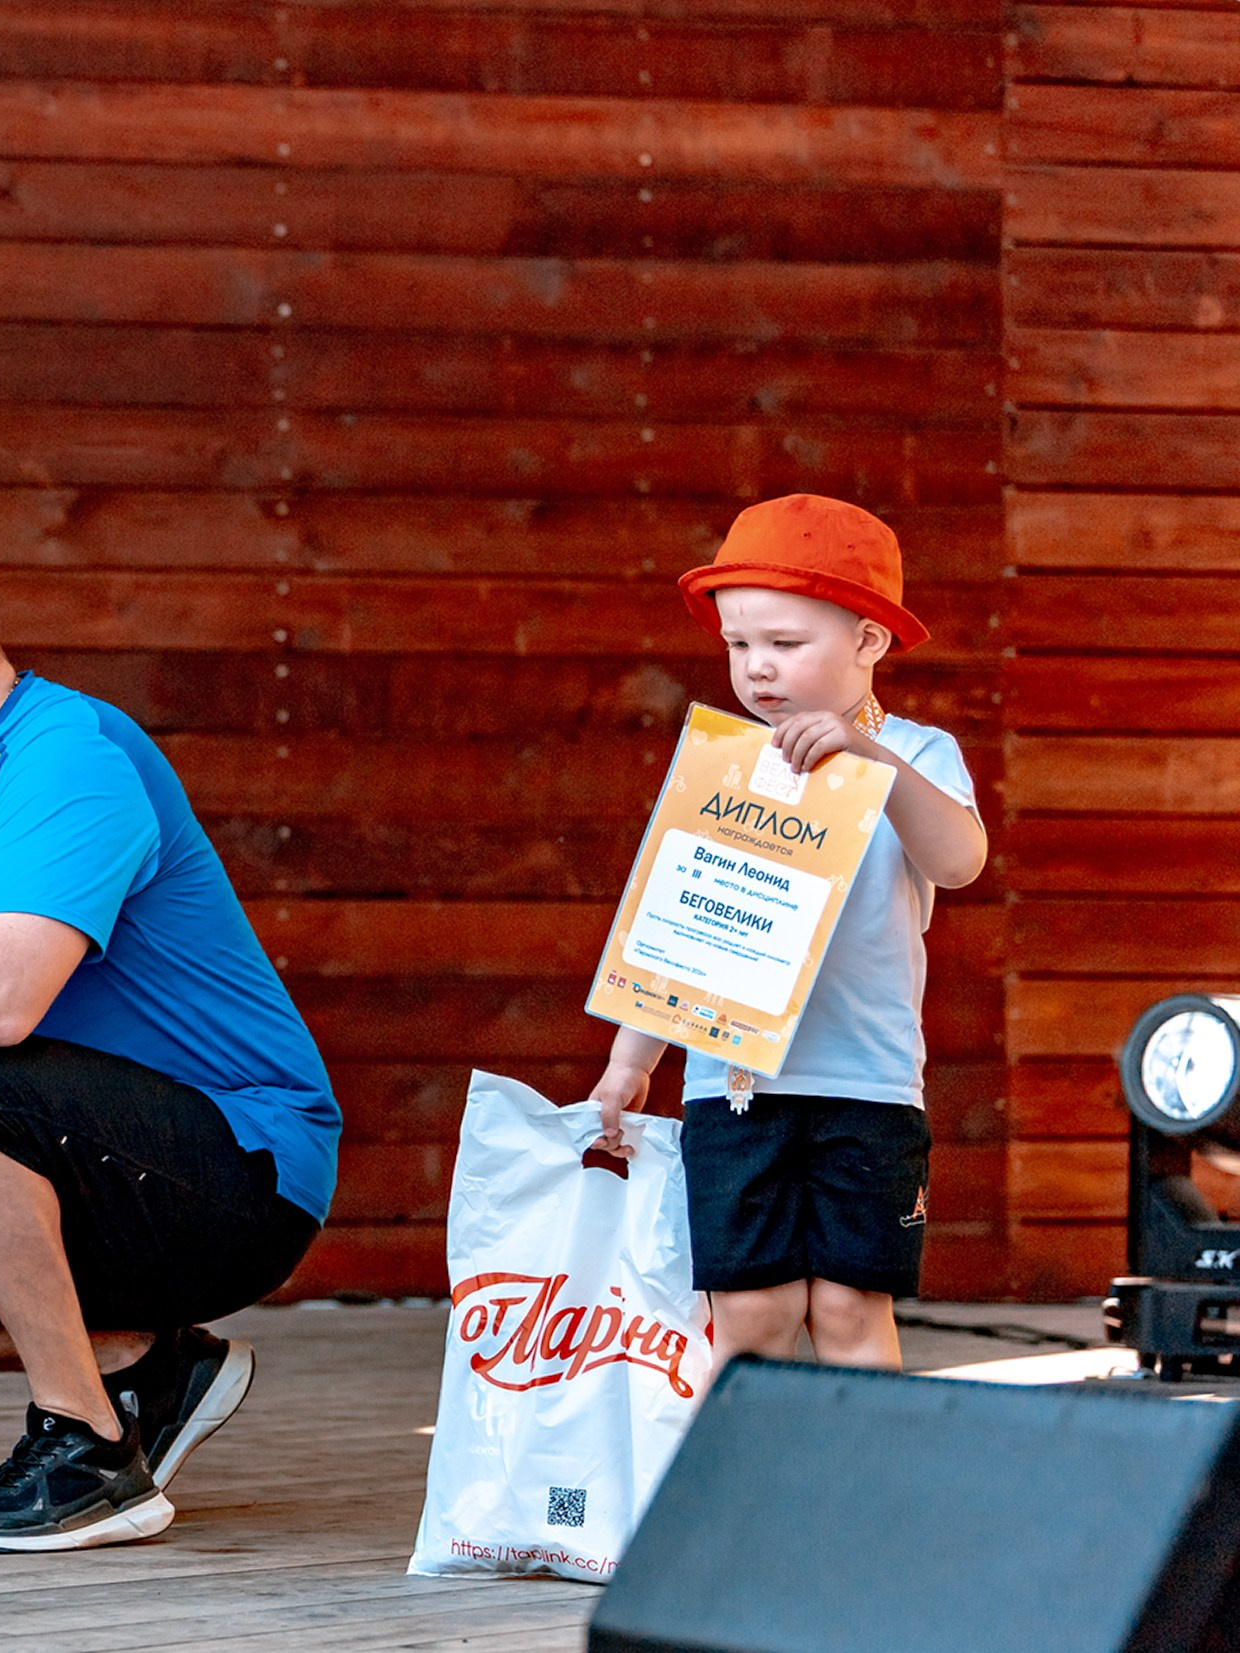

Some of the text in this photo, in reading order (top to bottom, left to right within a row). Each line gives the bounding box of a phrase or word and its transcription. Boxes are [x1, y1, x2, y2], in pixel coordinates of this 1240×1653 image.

[699, 791, 828, 850] ДИПЛОМ
[716, 824, 794, 857] награждается
[676, 864, 687, 873] за
[713, 878, 740, 891] место
[746, 889, 799, 911] дисциплине
[693, 846, 790, 893] Вагин Леонид
[679, 889, 774, 934] БЕГОВЕЛИКИ
[693, 914, 729, 930] КАТЕГОРИЯ
[459, 1296, 528, 1342] от
